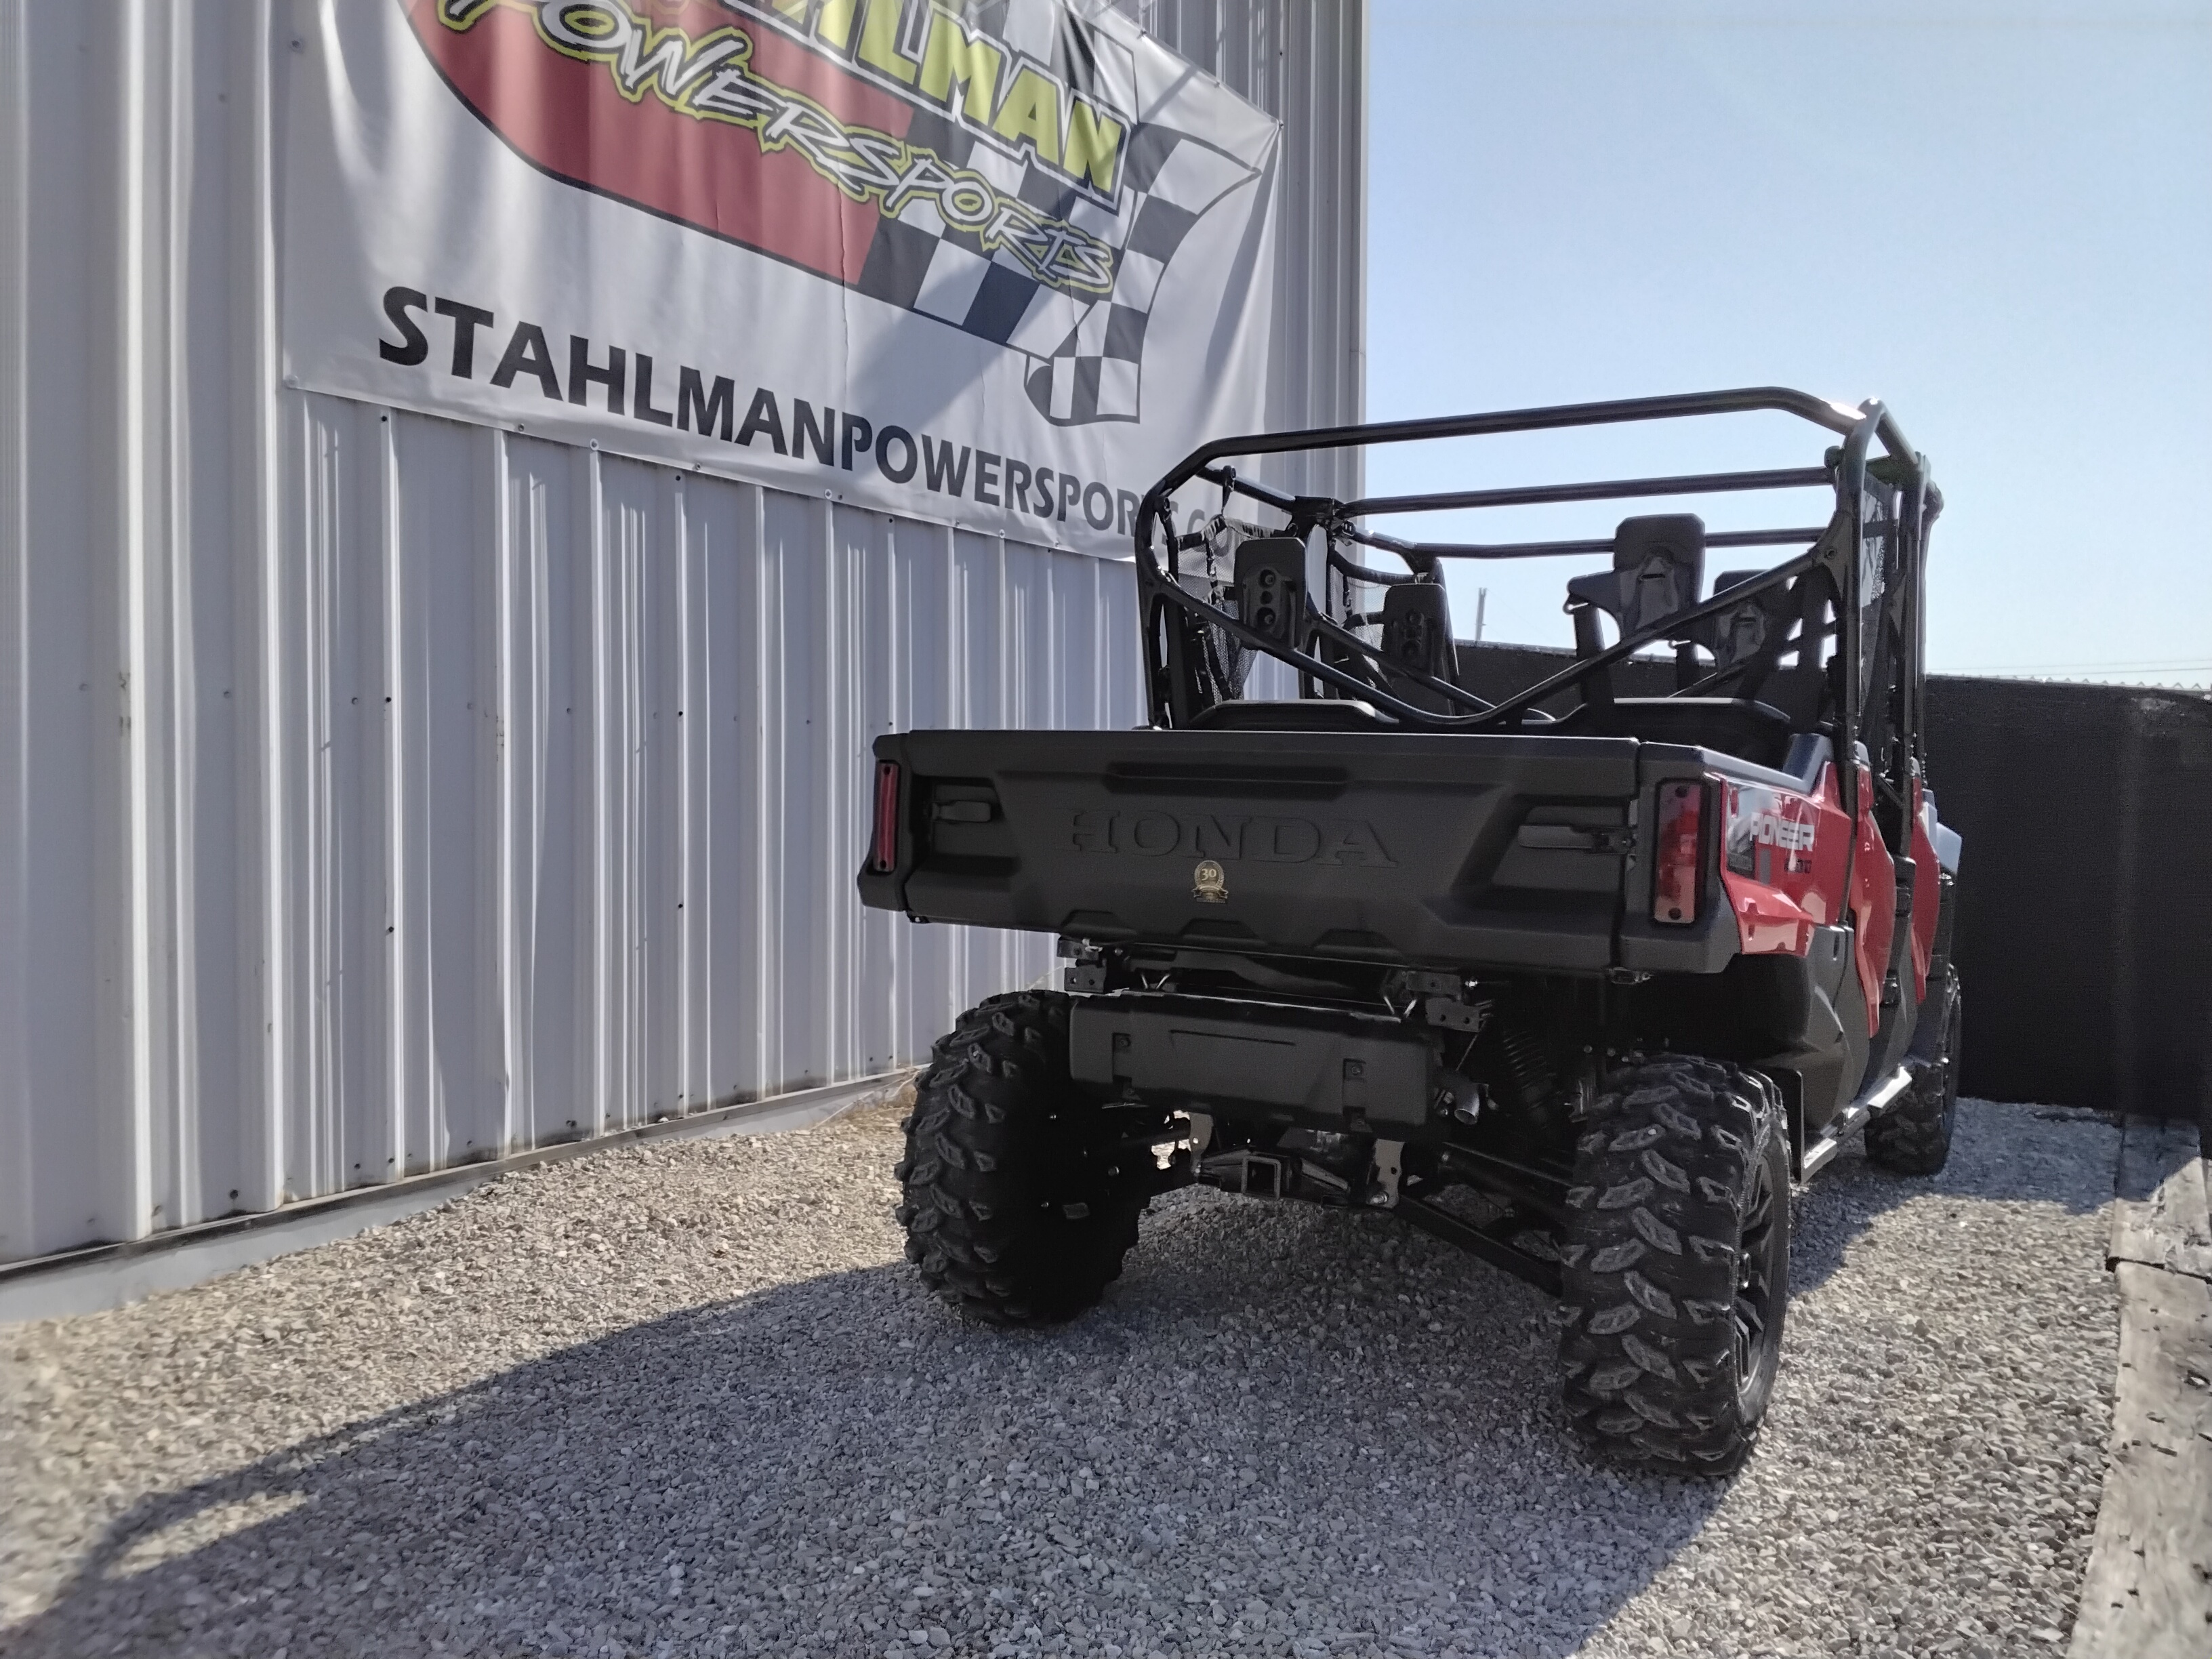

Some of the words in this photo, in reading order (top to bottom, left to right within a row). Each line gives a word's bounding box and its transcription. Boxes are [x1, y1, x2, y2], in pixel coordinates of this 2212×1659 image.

[442, 0, 1113, 291] OWERSPORTS
[1055, 808, 1399, 869] HONDA
[1749, 812, 1815, 852] PIONEER
[1201, 868, 1217, 881] 30
